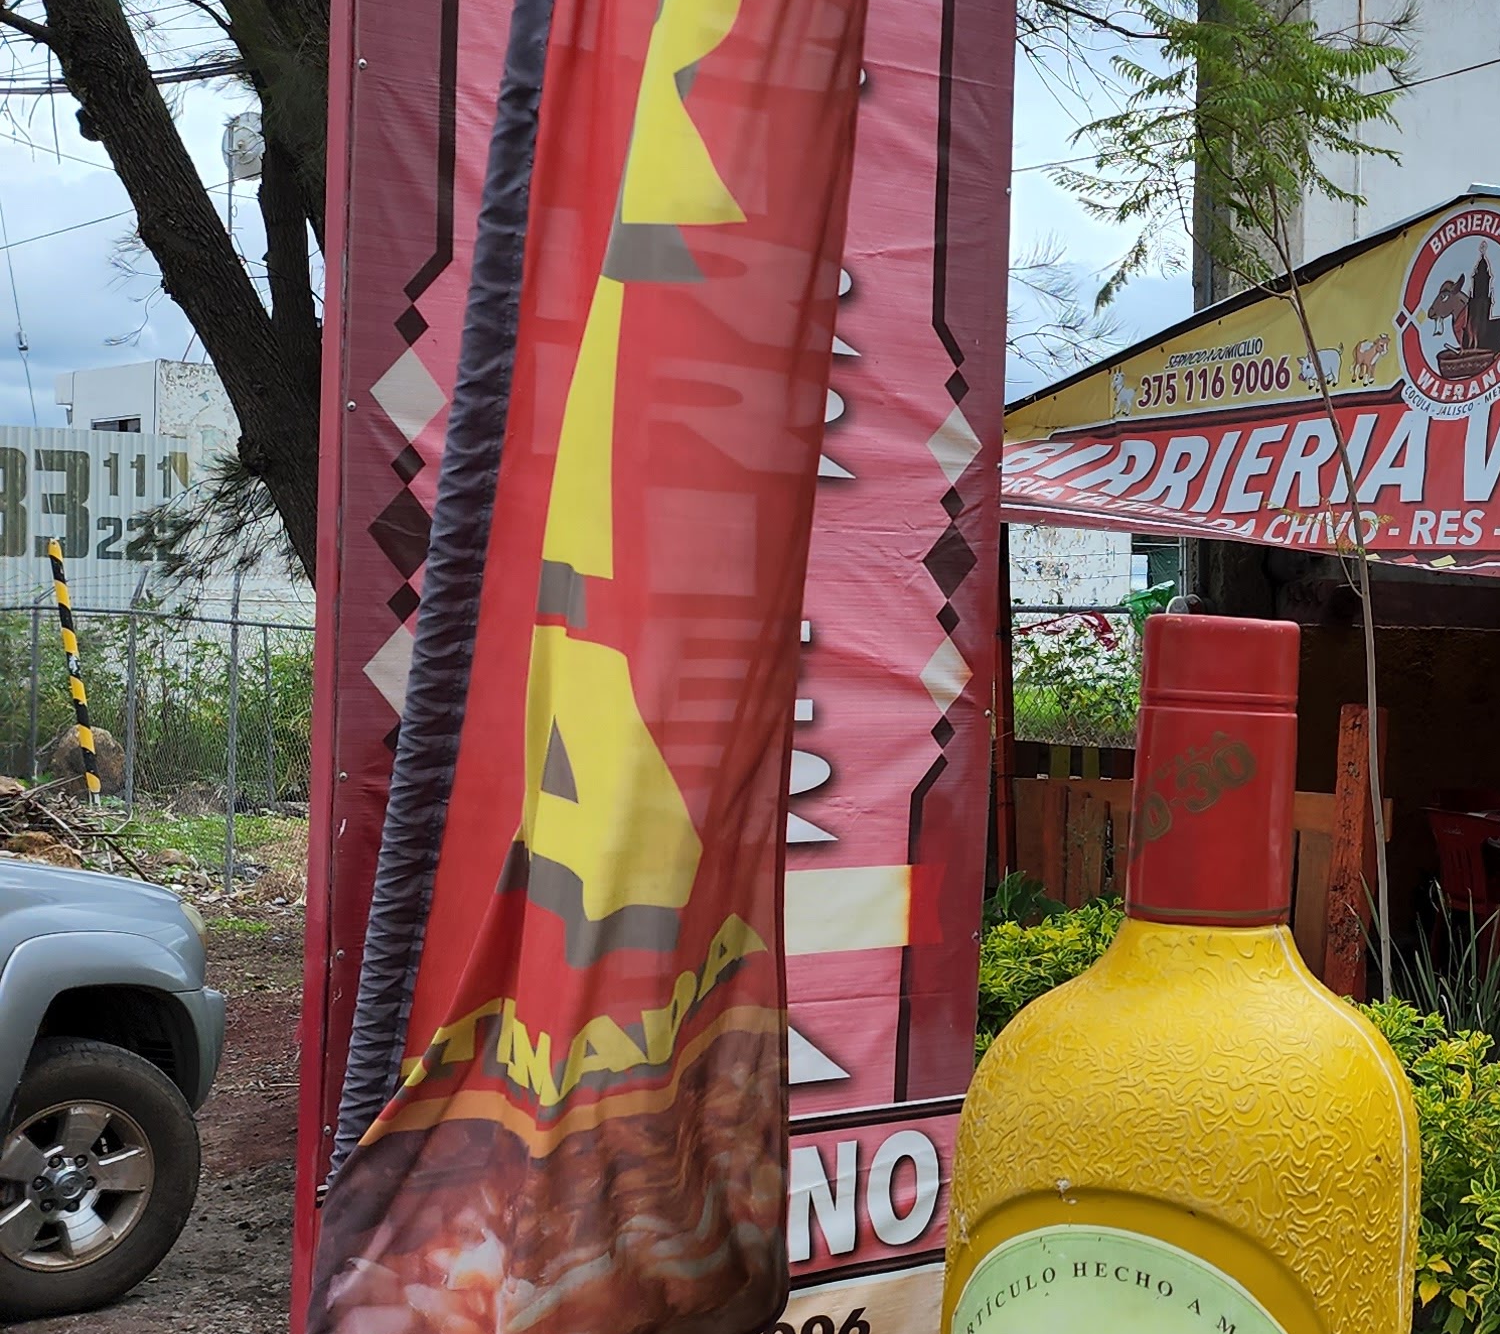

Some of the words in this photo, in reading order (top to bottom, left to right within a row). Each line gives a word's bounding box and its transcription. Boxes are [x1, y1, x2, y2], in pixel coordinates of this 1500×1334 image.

[1137, 373, 1177, 407] 375
[1184, 366, 1225, 402] 116
[1231, 357, 1291, 396] 9006
[1404, 385, 1432, 414] COCULA
[1436, 402, 1474, 416] JALISCO
[1003, 404, 1427, 515] BIRRIERIA
[1263, 511, 1379, 545] CHIVO
[1409, 511, 1482, 547] RES
[1073, 1262, 1174, 1298] HECHO
[1187, 1298, 1202, 1316] A
